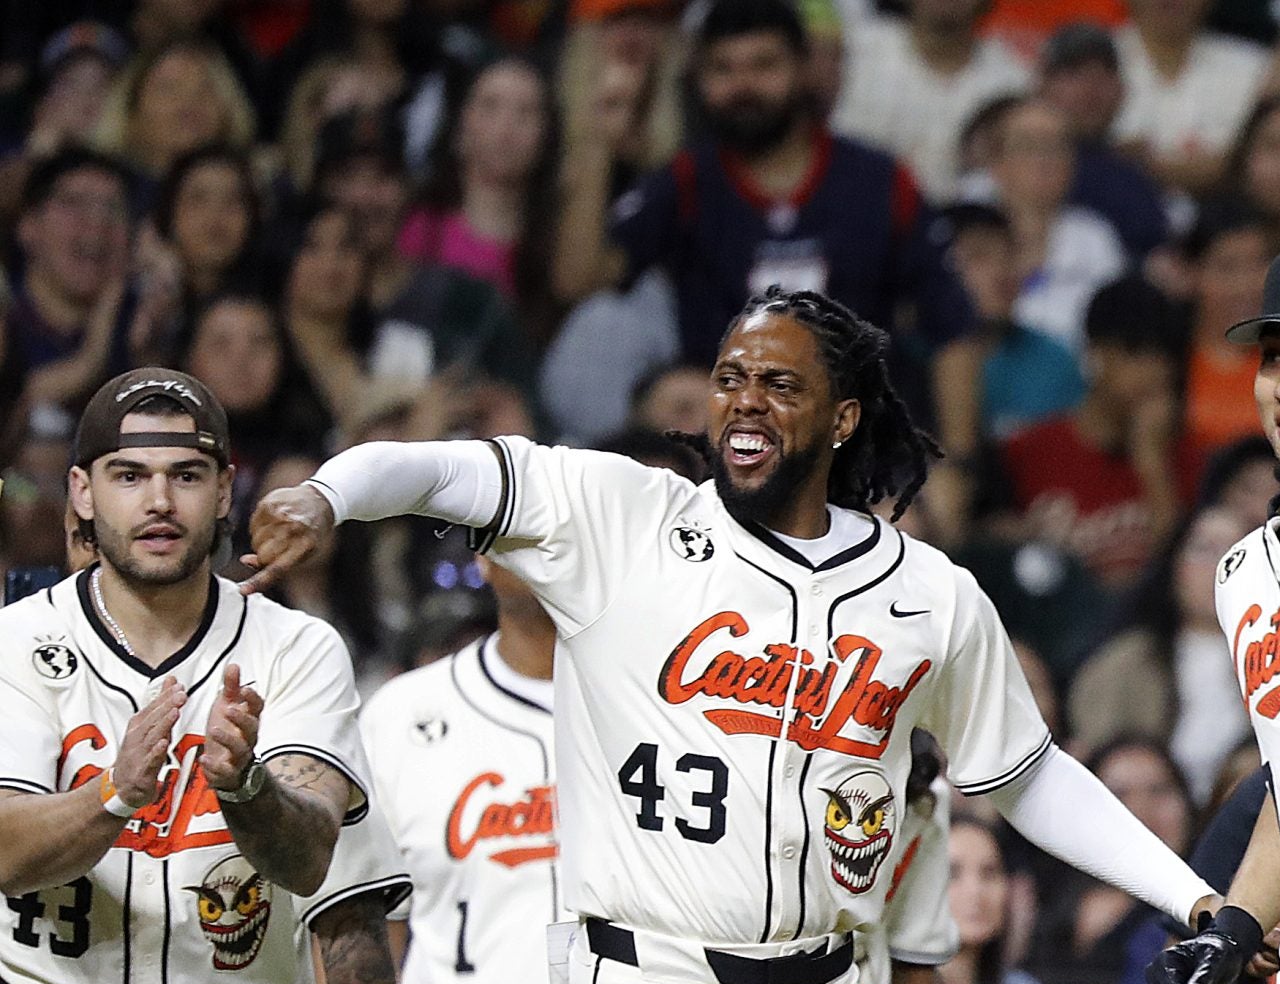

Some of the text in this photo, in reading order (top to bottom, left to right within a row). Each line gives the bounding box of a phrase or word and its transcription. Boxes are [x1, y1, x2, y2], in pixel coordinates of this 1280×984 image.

[657, 610, 838, 717] Cactus
[617, 742, 729, 844] 43
[455, 901, 475, 973] 1
